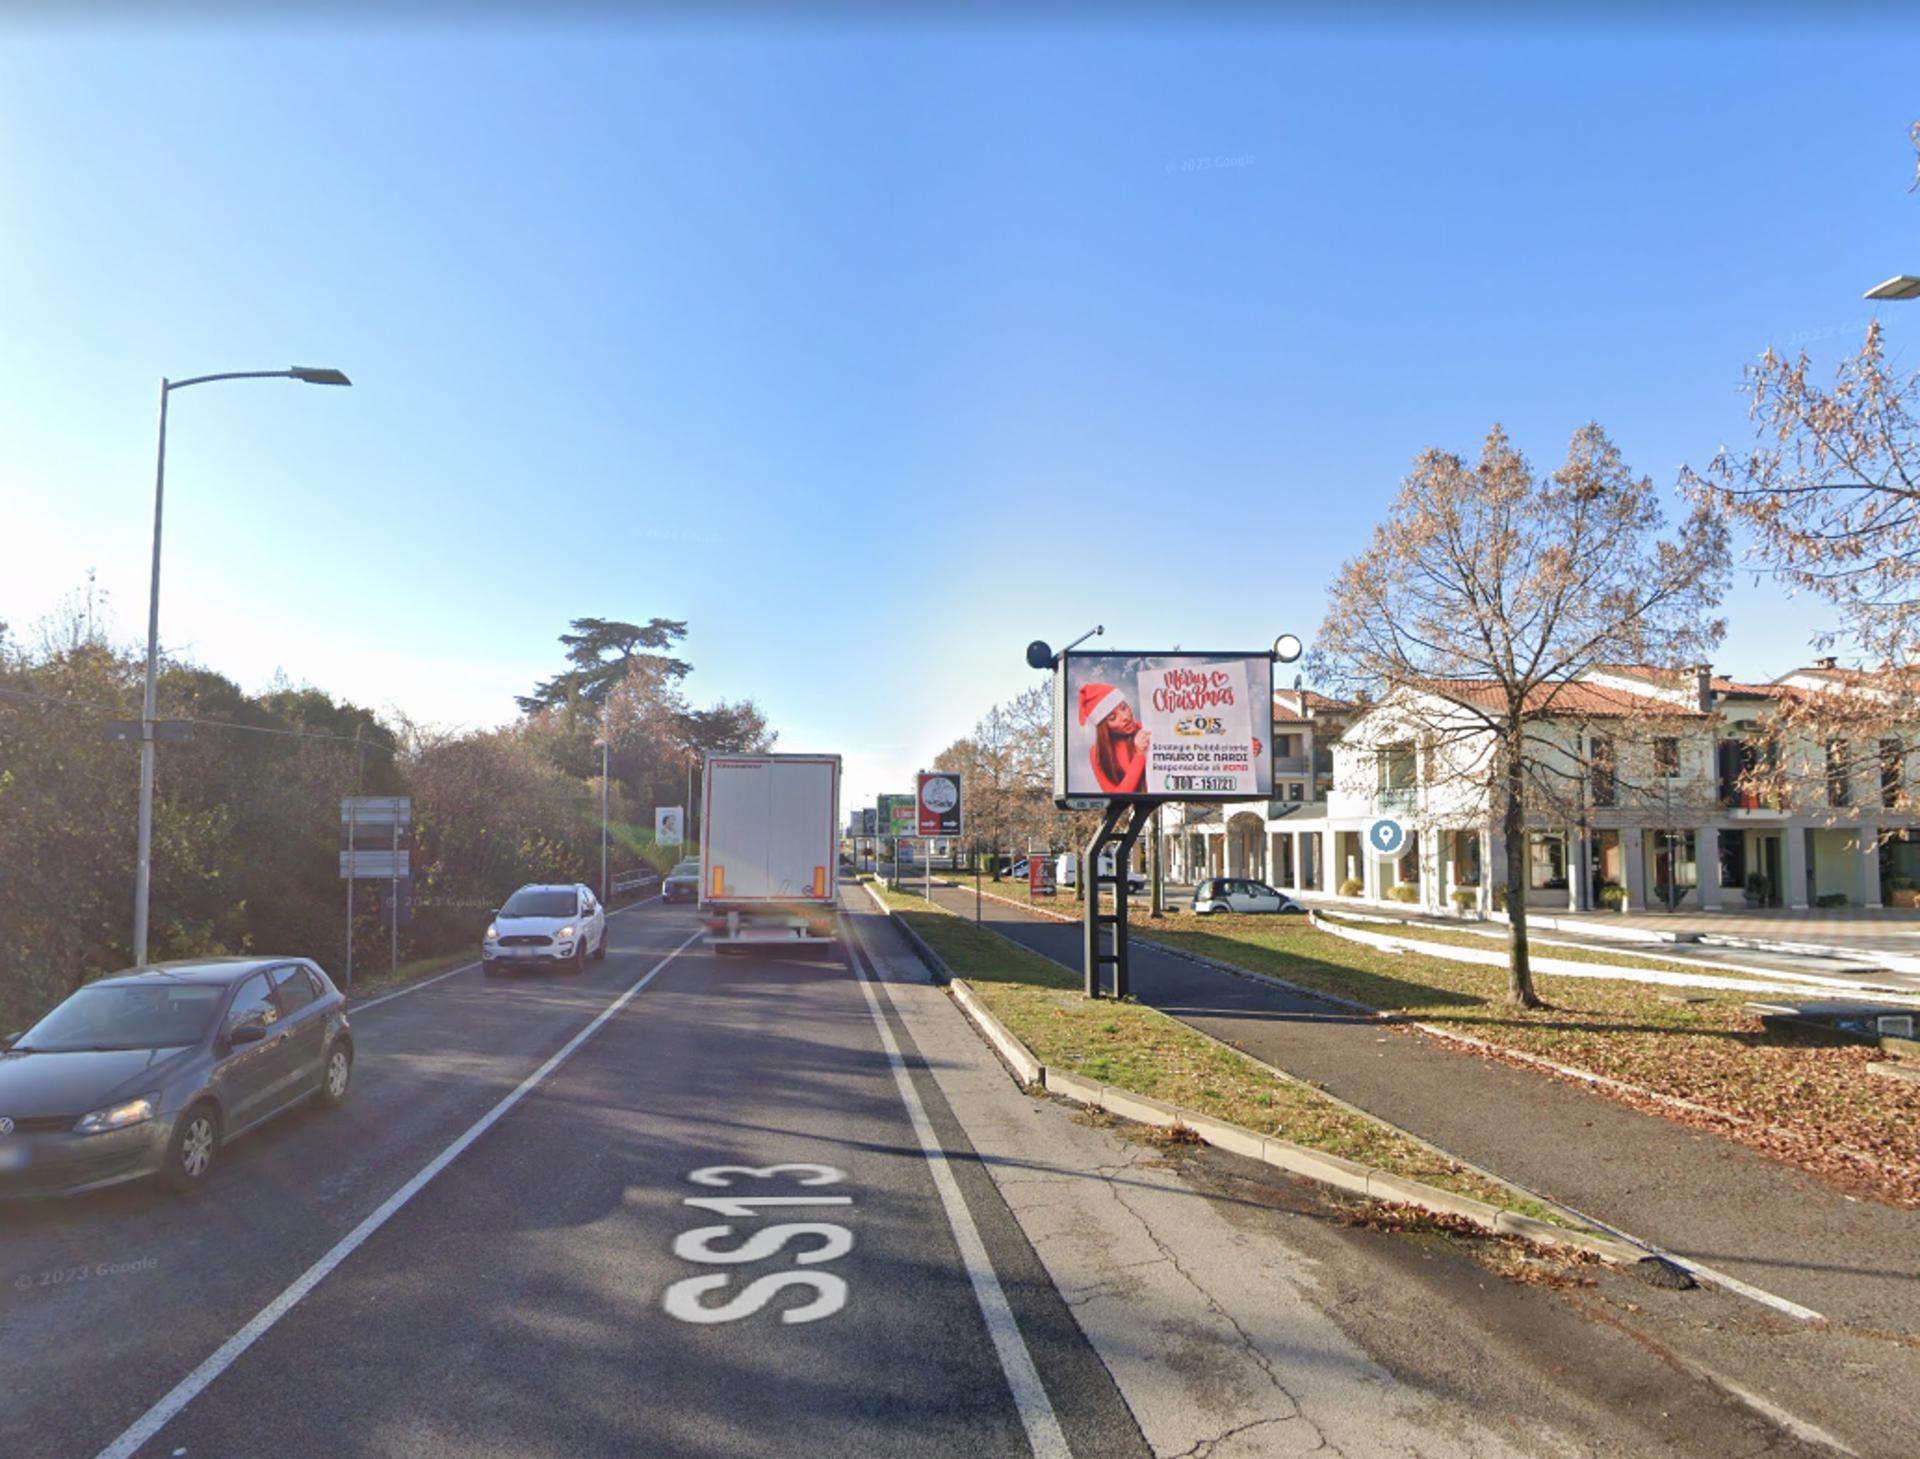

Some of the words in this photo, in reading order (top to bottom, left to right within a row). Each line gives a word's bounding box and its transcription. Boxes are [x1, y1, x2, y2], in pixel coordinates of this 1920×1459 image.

[1164, 668, 1208, 693] Merry
[1153, 685, 1235, 713] Christmas
[1152, 752, 1195, 762] MAURO
[1197, 752, 1211, 762] DE
[663, 1163, 853, 1324] SS13
